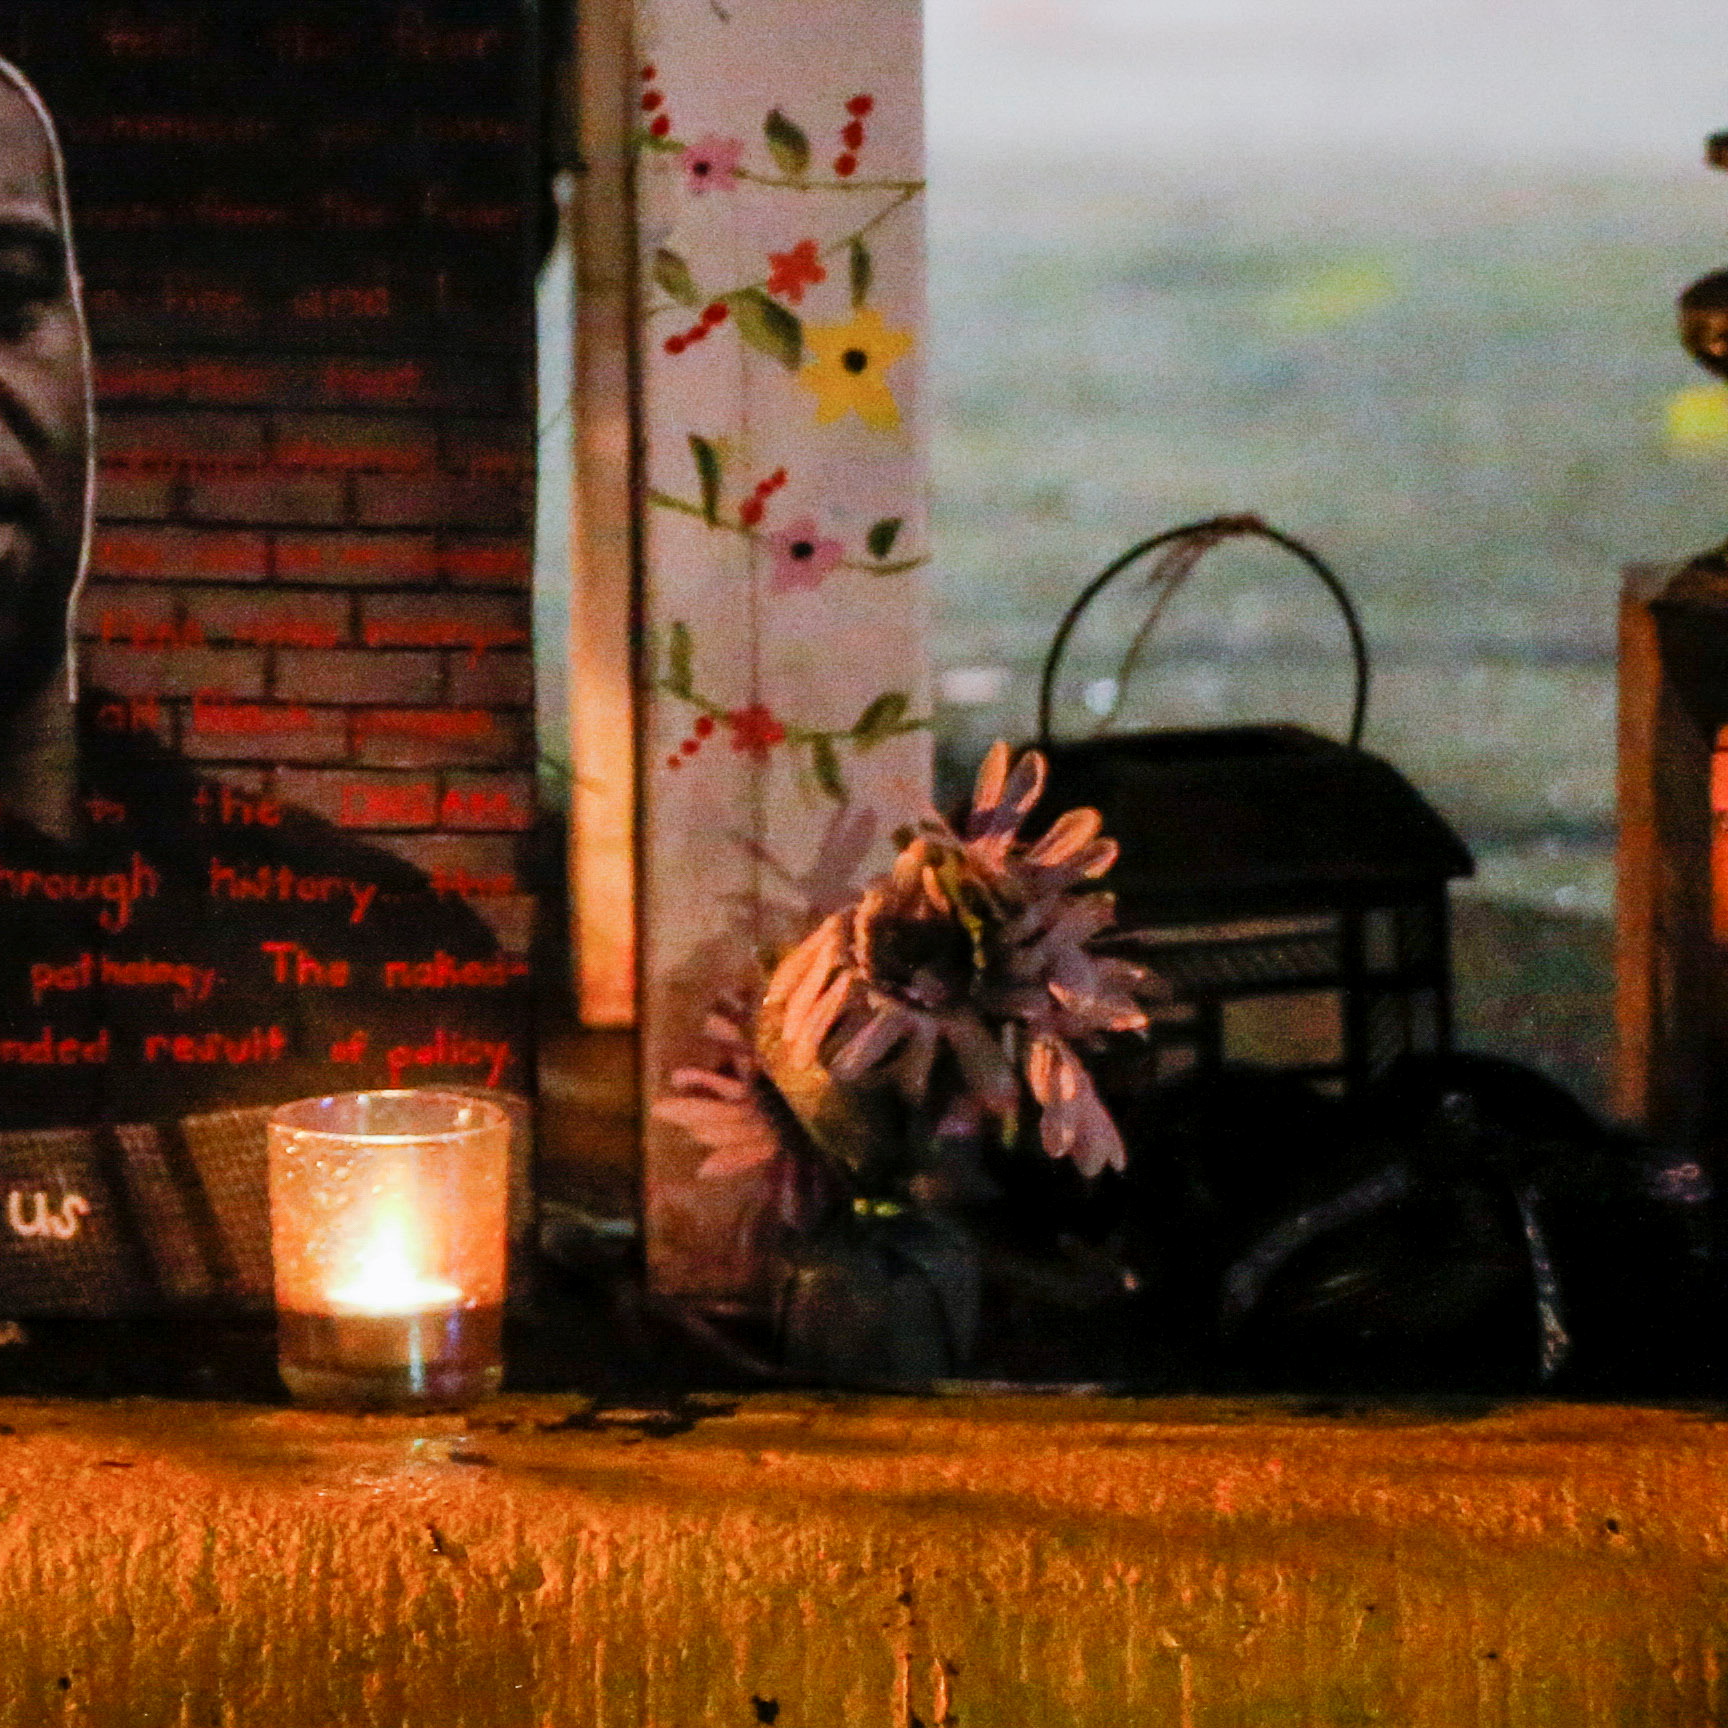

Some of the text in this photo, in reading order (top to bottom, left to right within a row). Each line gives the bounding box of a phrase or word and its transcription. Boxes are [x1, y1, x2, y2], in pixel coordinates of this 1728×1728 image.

[259, 938, 351, 988] The
[144, 1024, 287, 1066] result
[329, 1028, 370, 1063] of
